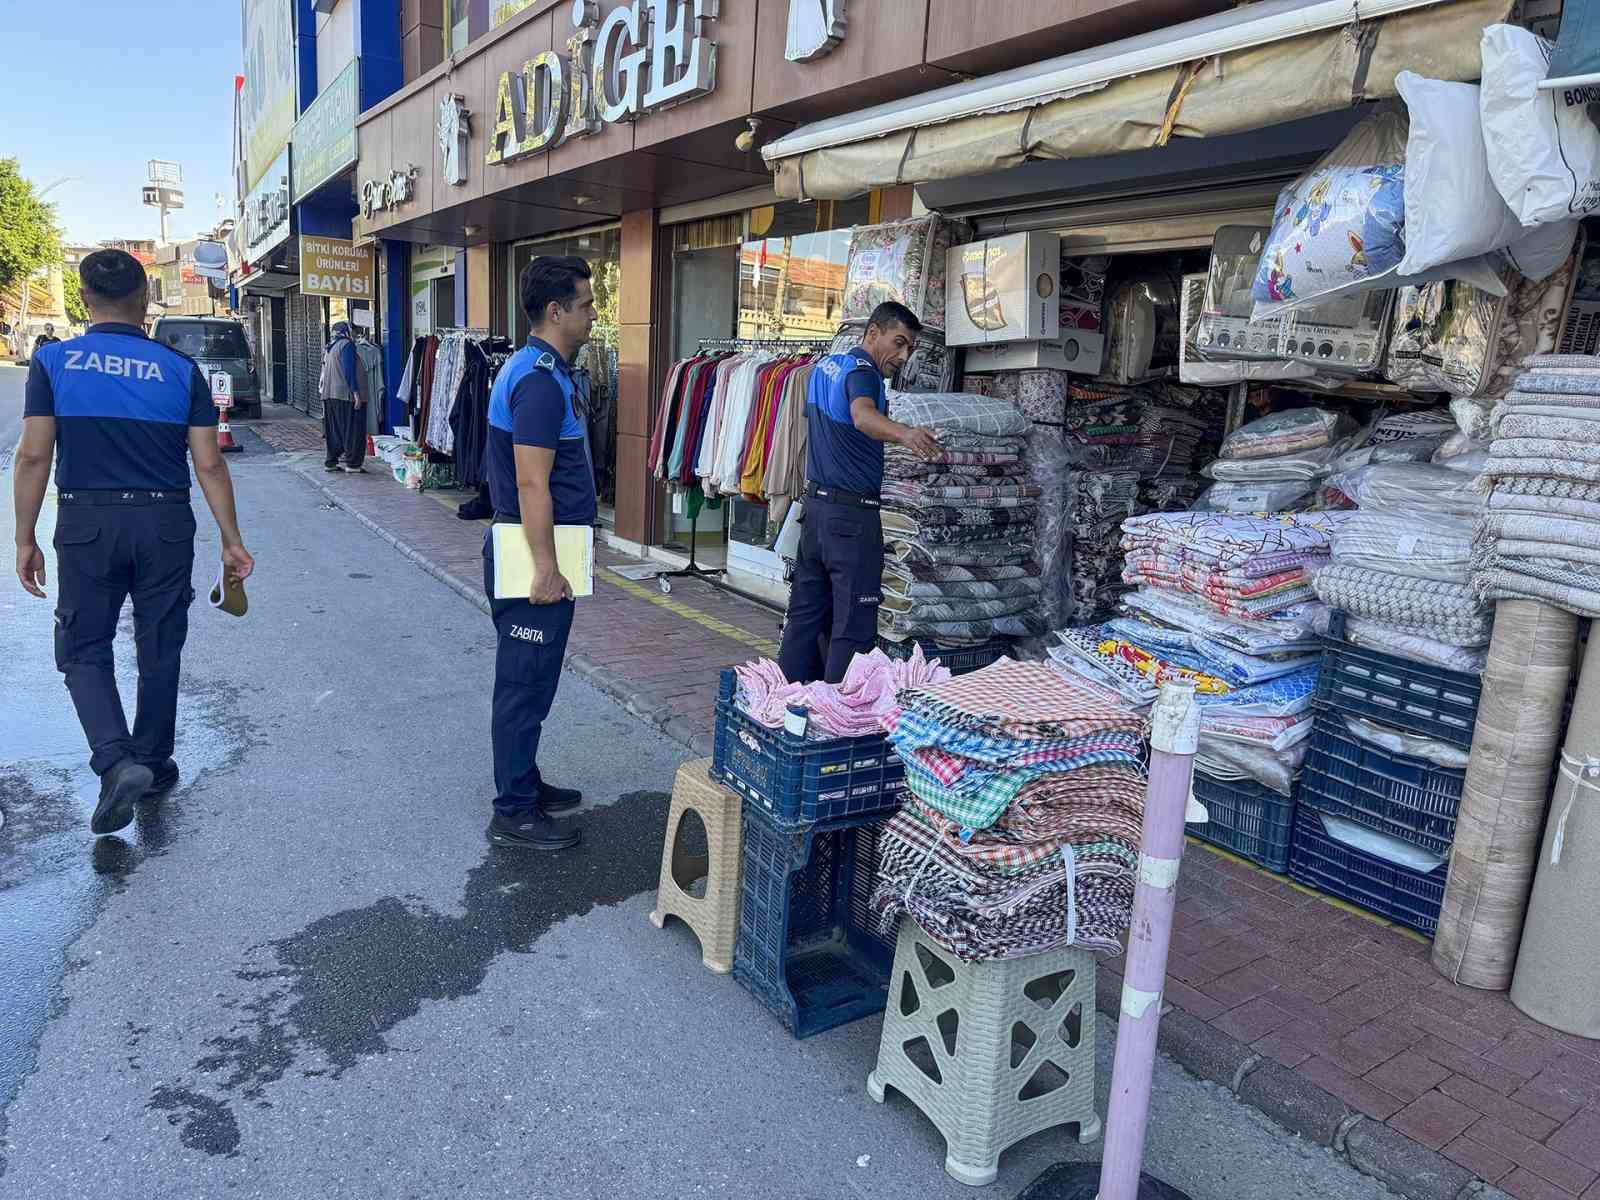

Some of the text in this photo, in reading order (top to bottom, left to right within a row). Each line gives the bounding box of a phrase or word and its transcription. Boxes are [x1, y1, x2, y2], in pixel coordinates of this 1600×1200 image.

[332, 246, 368, 258] KORUMA
[64, 350, 165, 382] ZABITA
[510, 625, 543, 642] ZABITA
